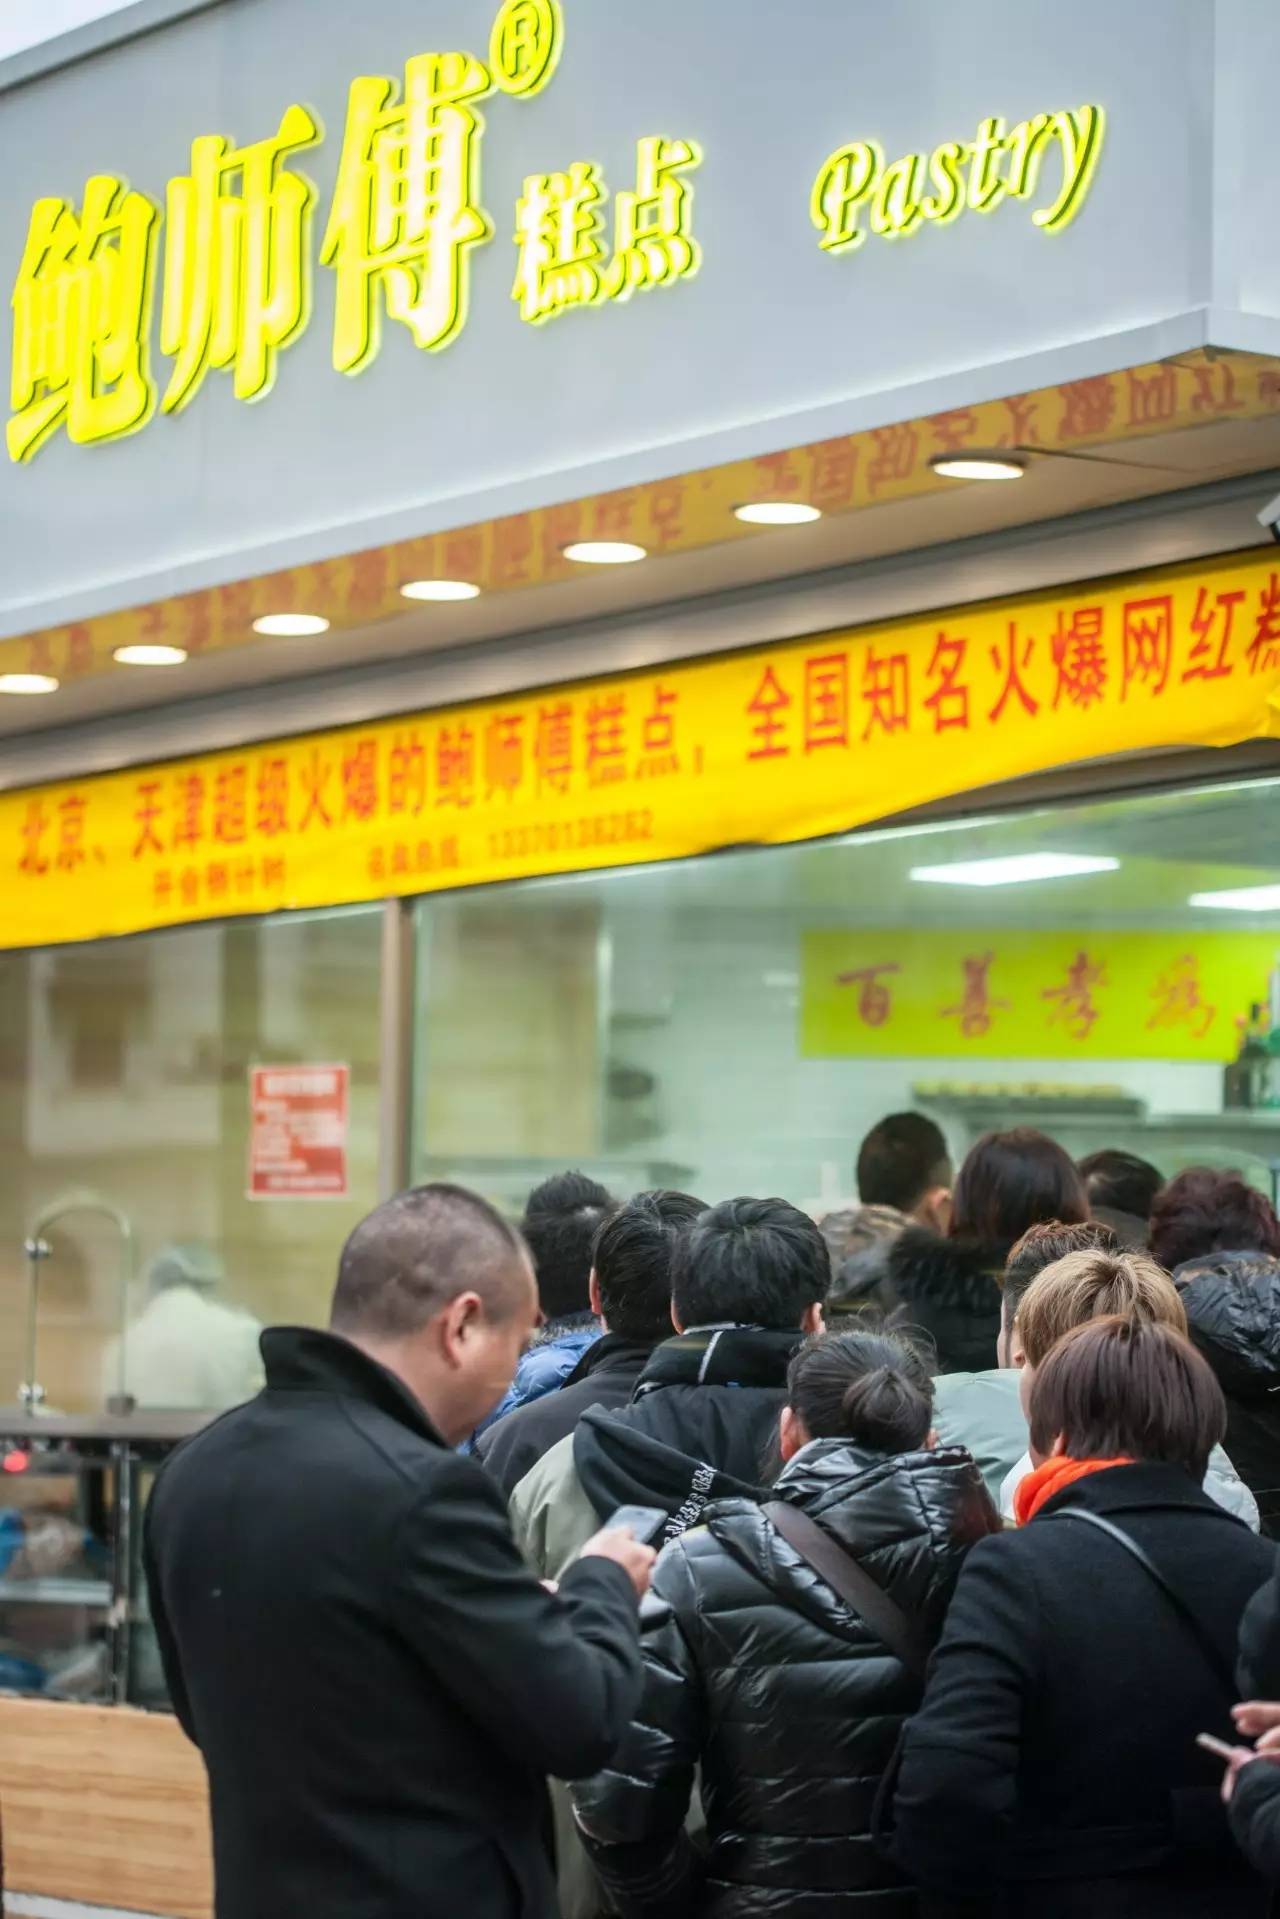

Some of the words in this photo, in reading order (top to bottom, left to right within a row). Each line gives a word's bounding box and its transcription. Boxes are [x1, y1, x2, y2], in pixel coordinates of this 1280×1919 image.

[7, 52, 492, 464] 鲍师傅
[512, 137, 702, 323] 糕点
[810, 104, 1104, 253] Pastry
